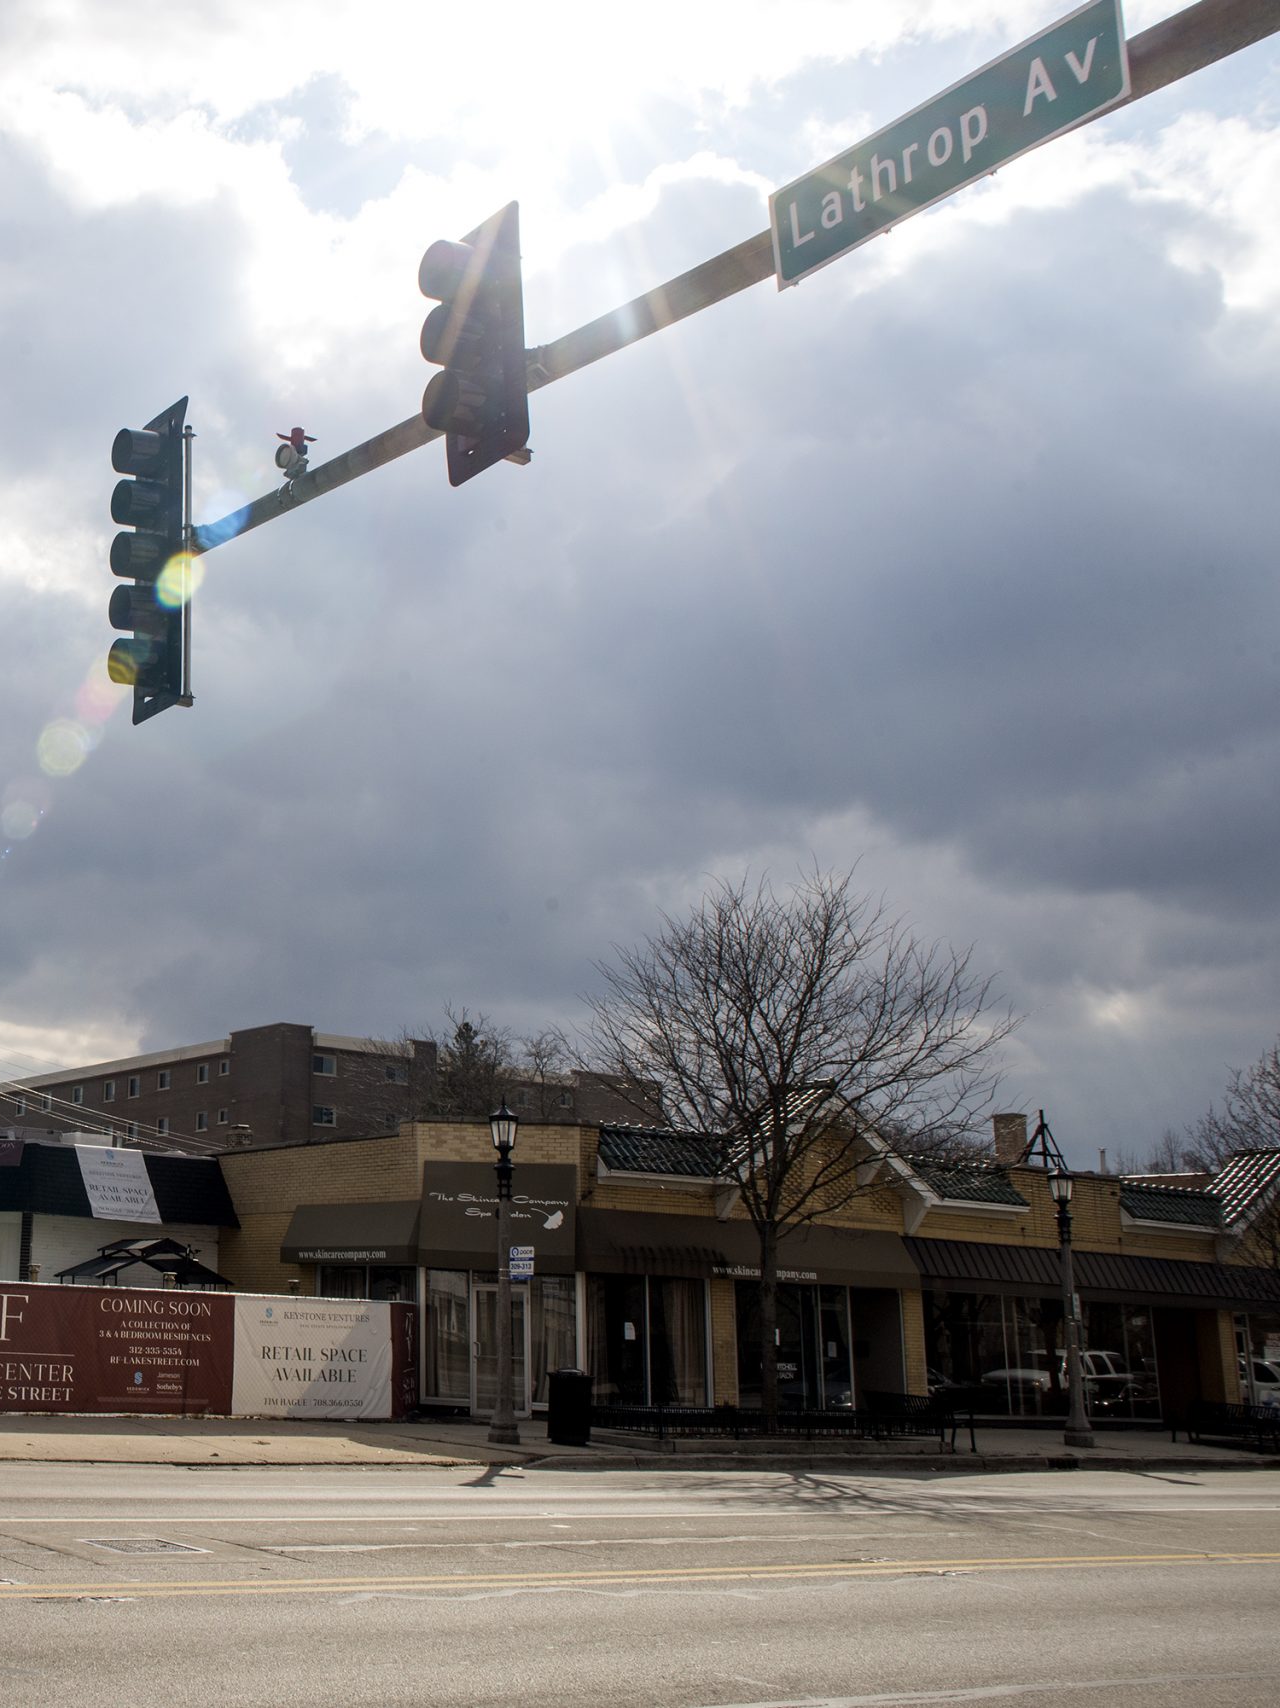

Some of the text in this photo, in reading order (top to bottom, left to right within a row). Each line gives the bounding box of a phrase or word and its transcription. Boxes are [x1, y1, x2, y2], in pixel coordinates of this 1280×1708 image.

[789, 36, 1097, 248] Lathrop Av
[429, 1192, 569, 1207] The Skinca Company
[465, 1207, 492, 1218] Spa
[298, 1249, 386, 1261] www.skincarecompany.com
[100, 1298, 211, 1317] COMING SOON
[283, 1311, 370, 1323] KEYSTONE VENTURES
[120, 1320, 192, 1330] A COLLECTION OF
[105, 1330, 112, 1338] &
[113, 1330, 119, 1338] 4
[120, 1331, 162, 1340] BEDROOM
[163, 1332, 211, 1342] RESIDENCES
[129, 1346, 183, 1356] 312-335-5354
[262, 1346, 368, 1363] RETAIL SPACE
[110, 1356, 200, 1367] RF-LAKESTREET.COM
[273, 1367, 357, 1383] AVAILABLE
[7, 1386, 74, 1402] STREET
[264, 1398, 279, 1406] TIM
[280, 1398, 308, 1407] HAGUE
